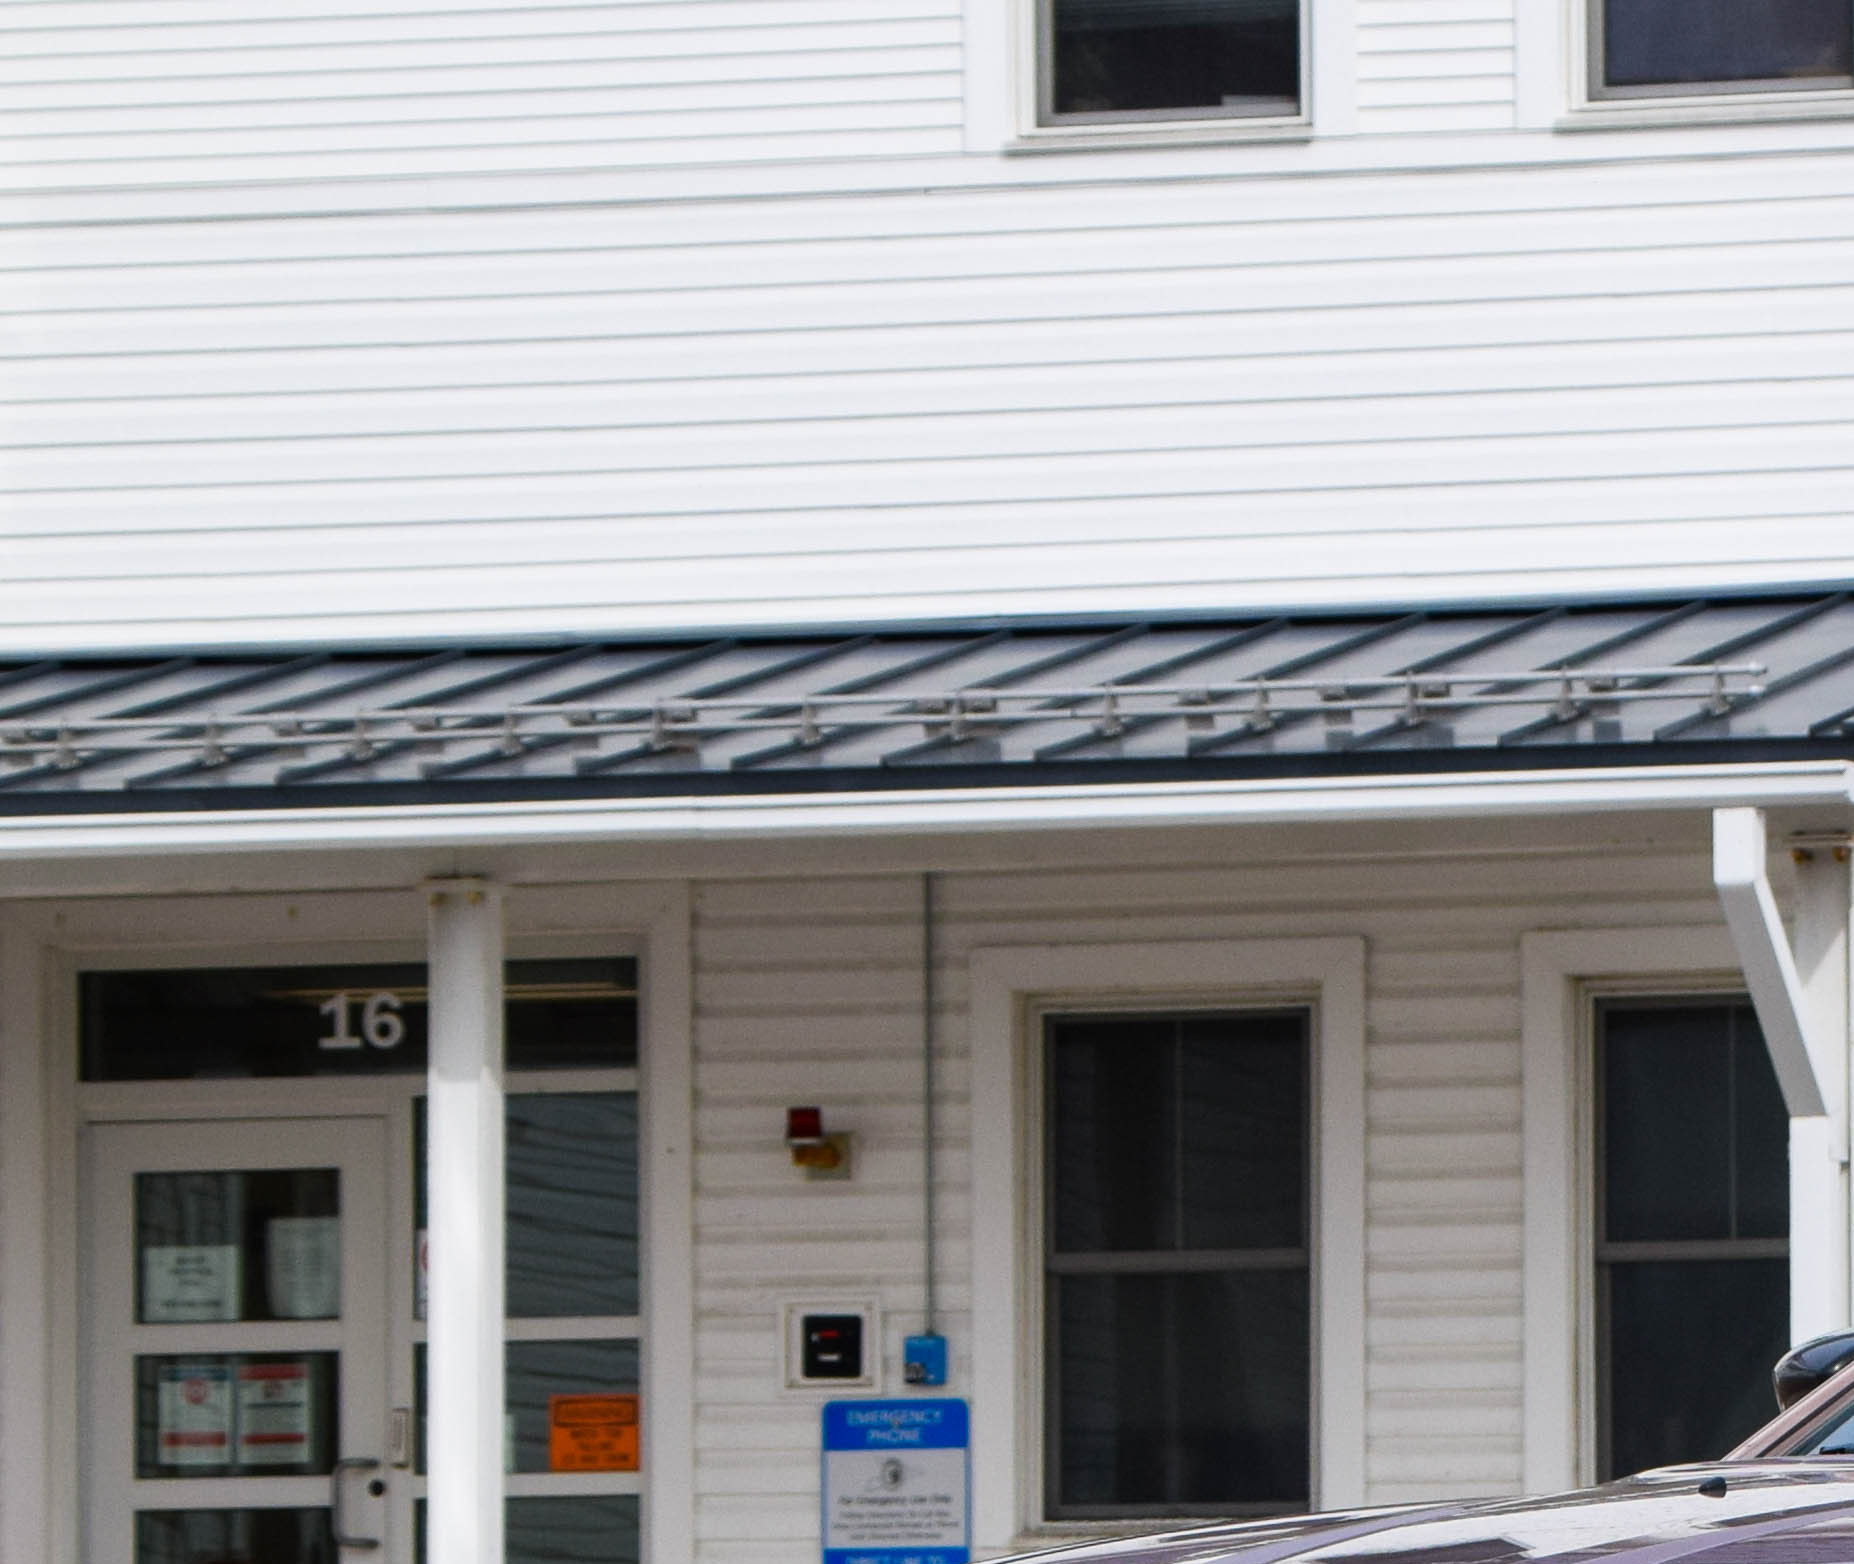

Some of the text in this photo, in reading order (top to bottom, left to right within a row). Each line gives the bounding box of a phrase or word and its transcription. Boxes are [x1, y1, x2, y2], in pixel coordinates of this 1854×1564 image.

[318, 992, 406, 1049] 16
[846, 1409, 942, 1426] EMERGENCY
[866, 1428, 920, 1443] PHONE
